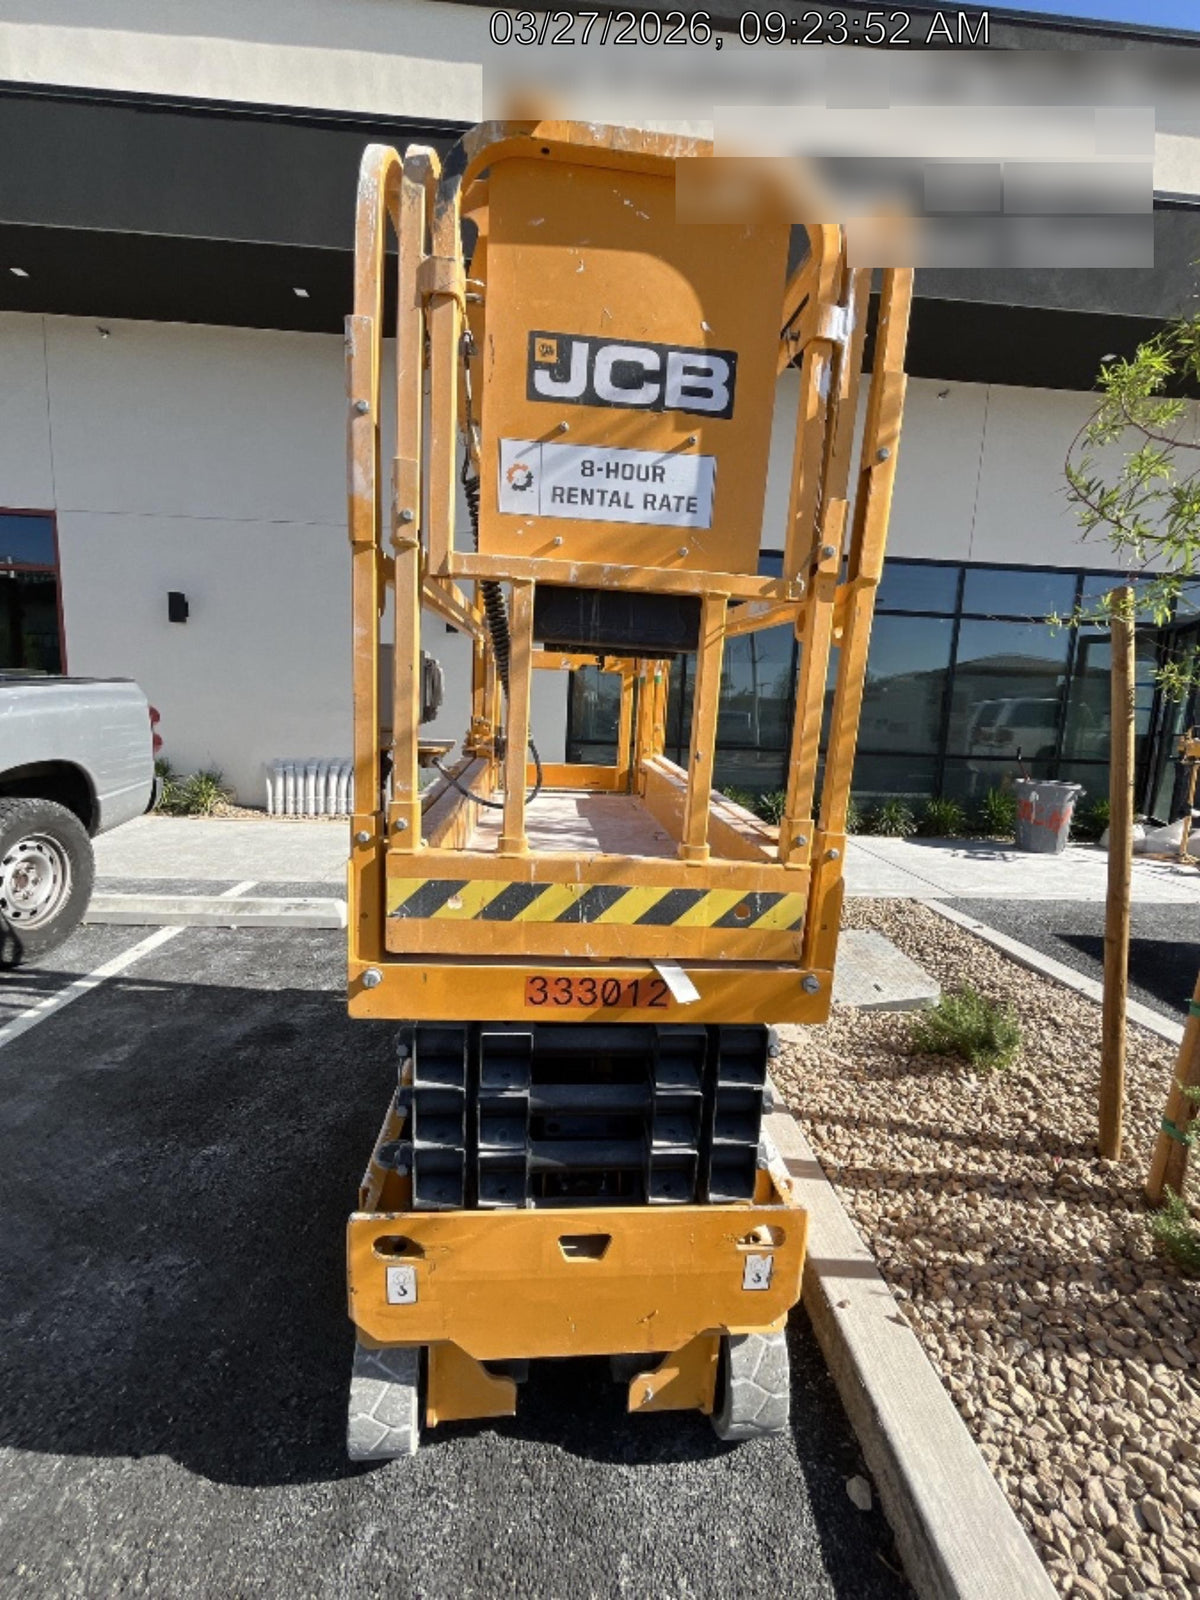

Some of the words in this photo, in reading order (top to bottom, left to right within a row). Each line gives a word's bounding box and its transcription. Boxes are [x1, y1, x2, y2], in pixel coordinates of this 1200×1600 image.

[533, 341, 730, 411] JCB
[580, 460, 666, 483] 8-HOUR
[551, 486, 635, 509] RENTAL
[643, 493, 698, 514] RATE
[528, 976, 669, 1007] 333012
